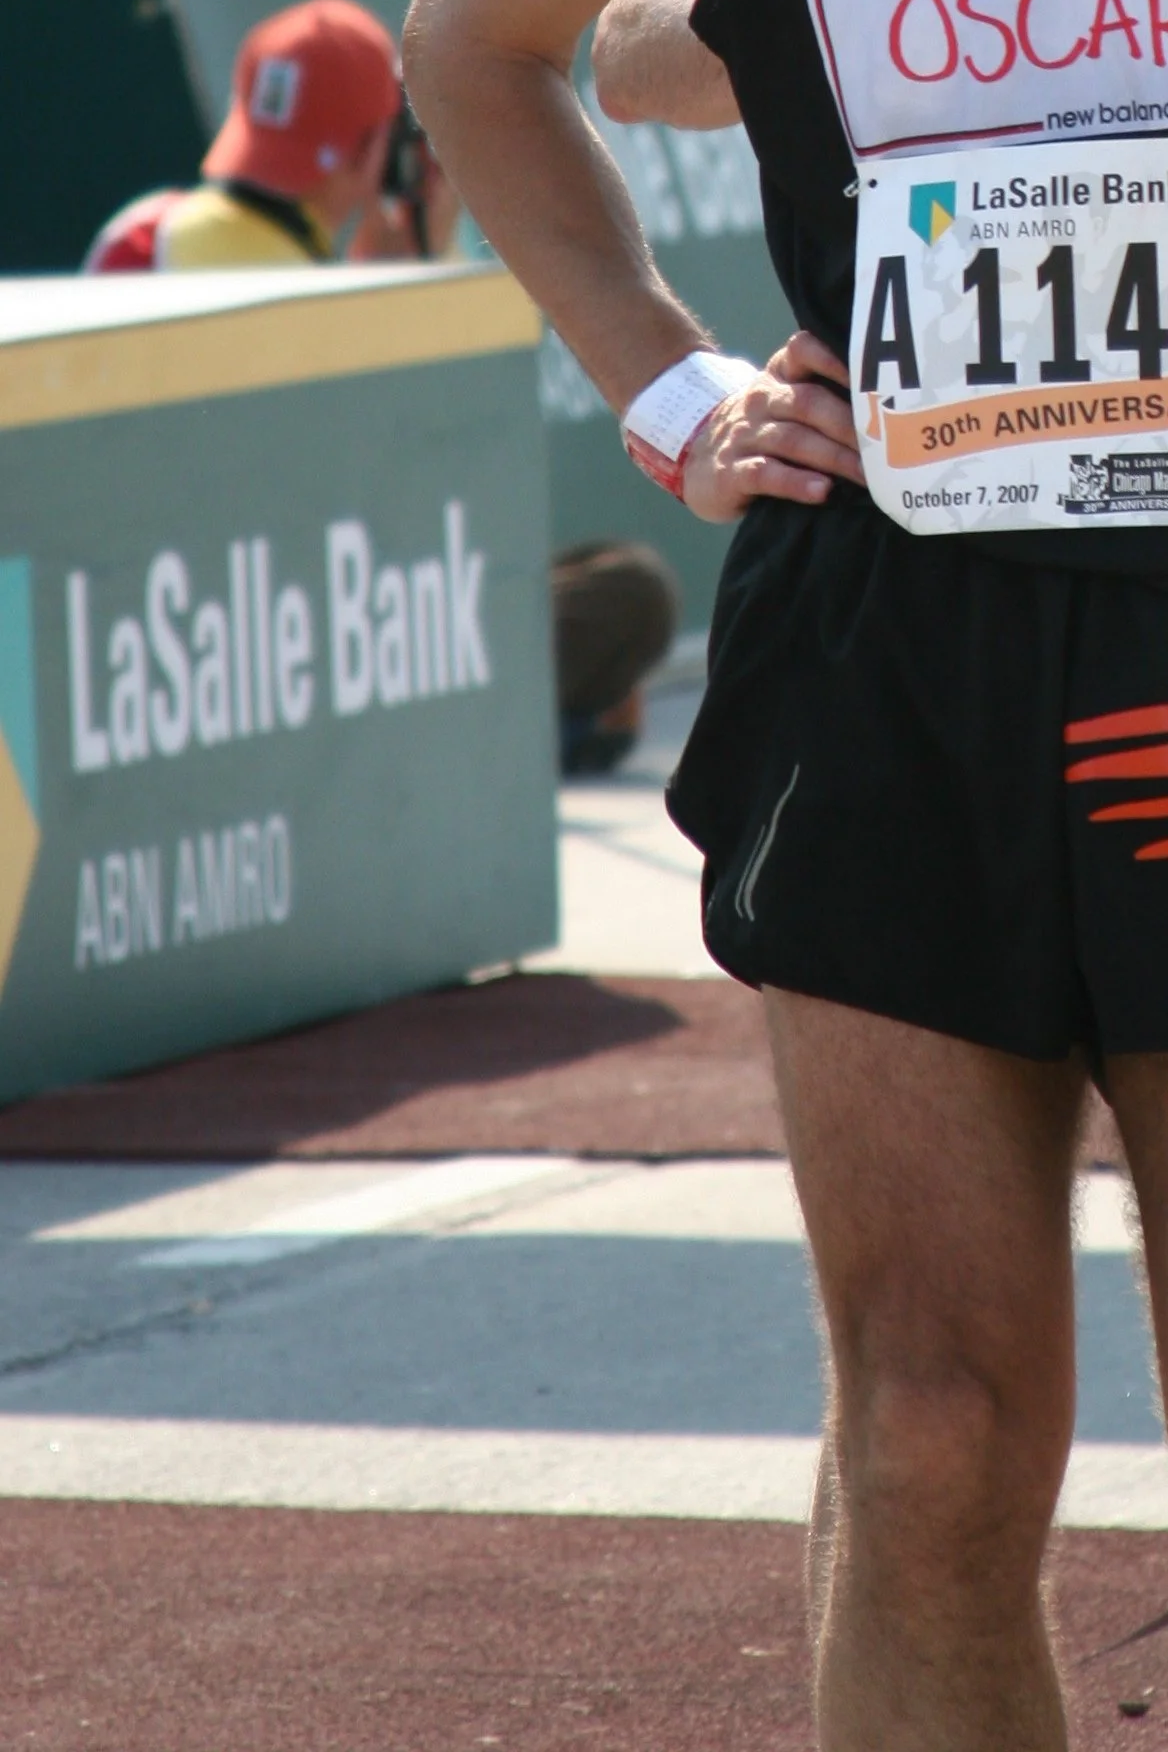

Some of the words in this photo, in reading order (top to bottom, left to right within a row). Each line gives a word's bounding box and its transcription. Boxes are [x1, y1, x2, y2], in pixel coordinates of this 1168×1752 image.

[1046, 106, 1095, 130] new
[971, 175, 1091, 212] LaSalle
[969, 219, 1010, 240] ABN
[1017, 218, 1076, 239] AMRO
[920, 412, 982, 451] 30th
[1112, 459, 1131, 468] The
[901, 487, 973, 509] October
[977, 486, 993, 507] 7,
[997, 484, 1039, 504] 2007
[1112, 472, 1152, 497] Chicago
[65, 535, 314, 774] LaSalle
[326, 498, 490, 717] Bank
[74, 845, 163, 970] ABN
[173, 813, 291, 946] AMRO
